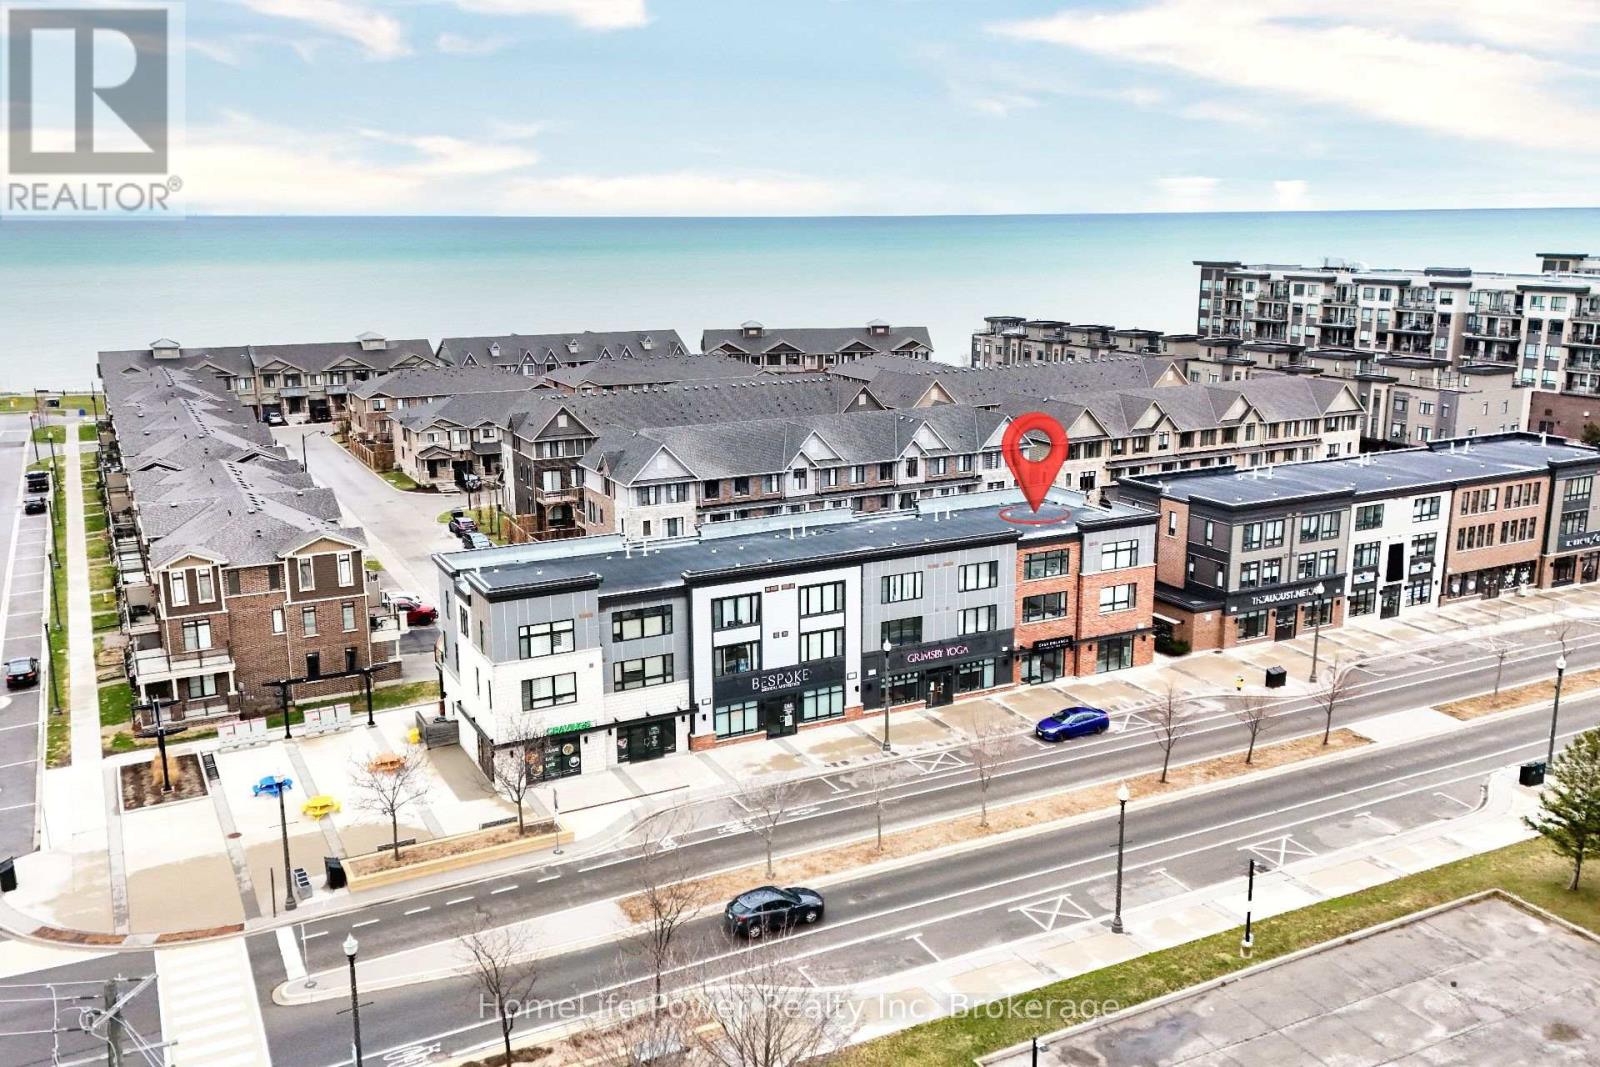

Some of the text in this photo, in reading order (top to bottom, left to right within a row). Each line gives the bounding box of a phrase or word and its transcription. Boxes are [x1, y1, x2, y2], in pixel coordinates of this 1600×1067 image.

[907, 645, 969, 662] GRIMSBY YOGA
[752, 668, 809, 690] BESPOKE
